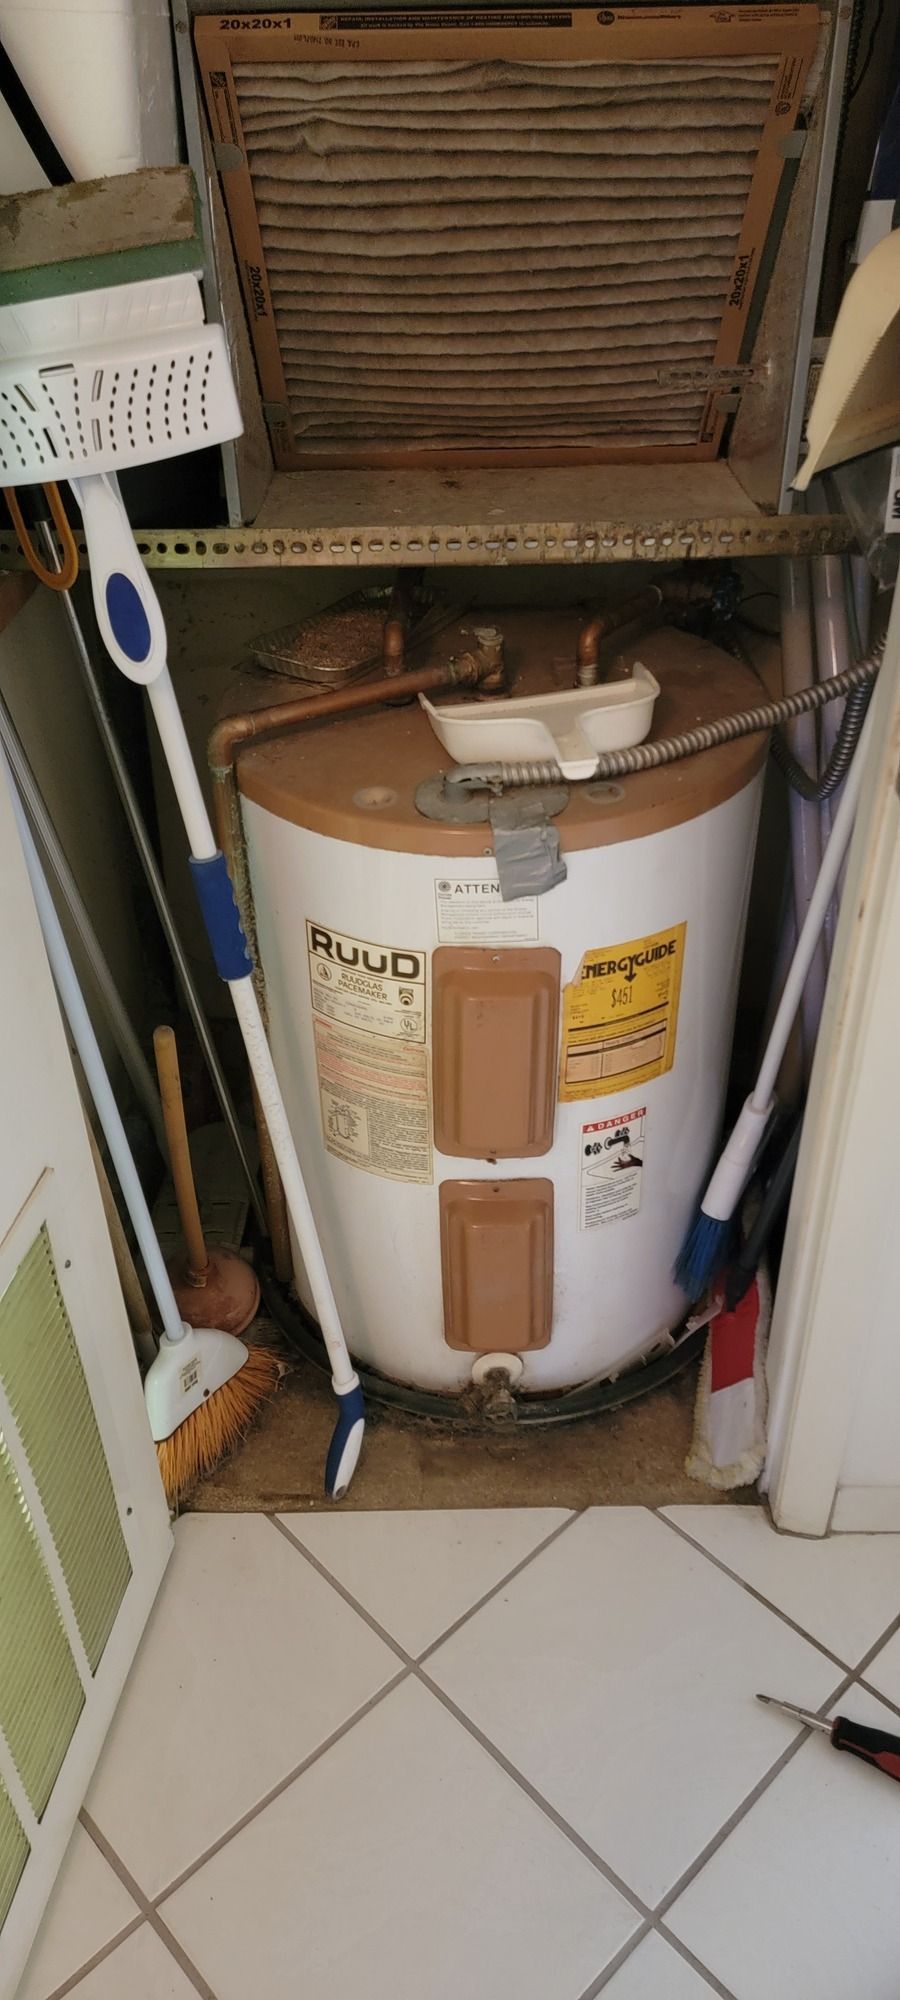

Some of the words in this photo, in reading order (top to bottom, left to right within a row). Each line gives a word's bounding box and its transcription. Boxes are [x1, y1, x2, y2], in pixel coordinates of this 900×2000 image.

[219, 18, 293, 31] 20x20x1
[249, 266, 268, 317] 20x20x1
[729, 255, 750, 306] 20x20x1
[311, 927, 420, 979] RUUD
[338, 979, 388, 1001] PACEMAKER
[341, 972, 383, 992] RUUDGLAS
[610, 985, 633, 1008] $451
[597, 1109, 644, 1130] DANGER
